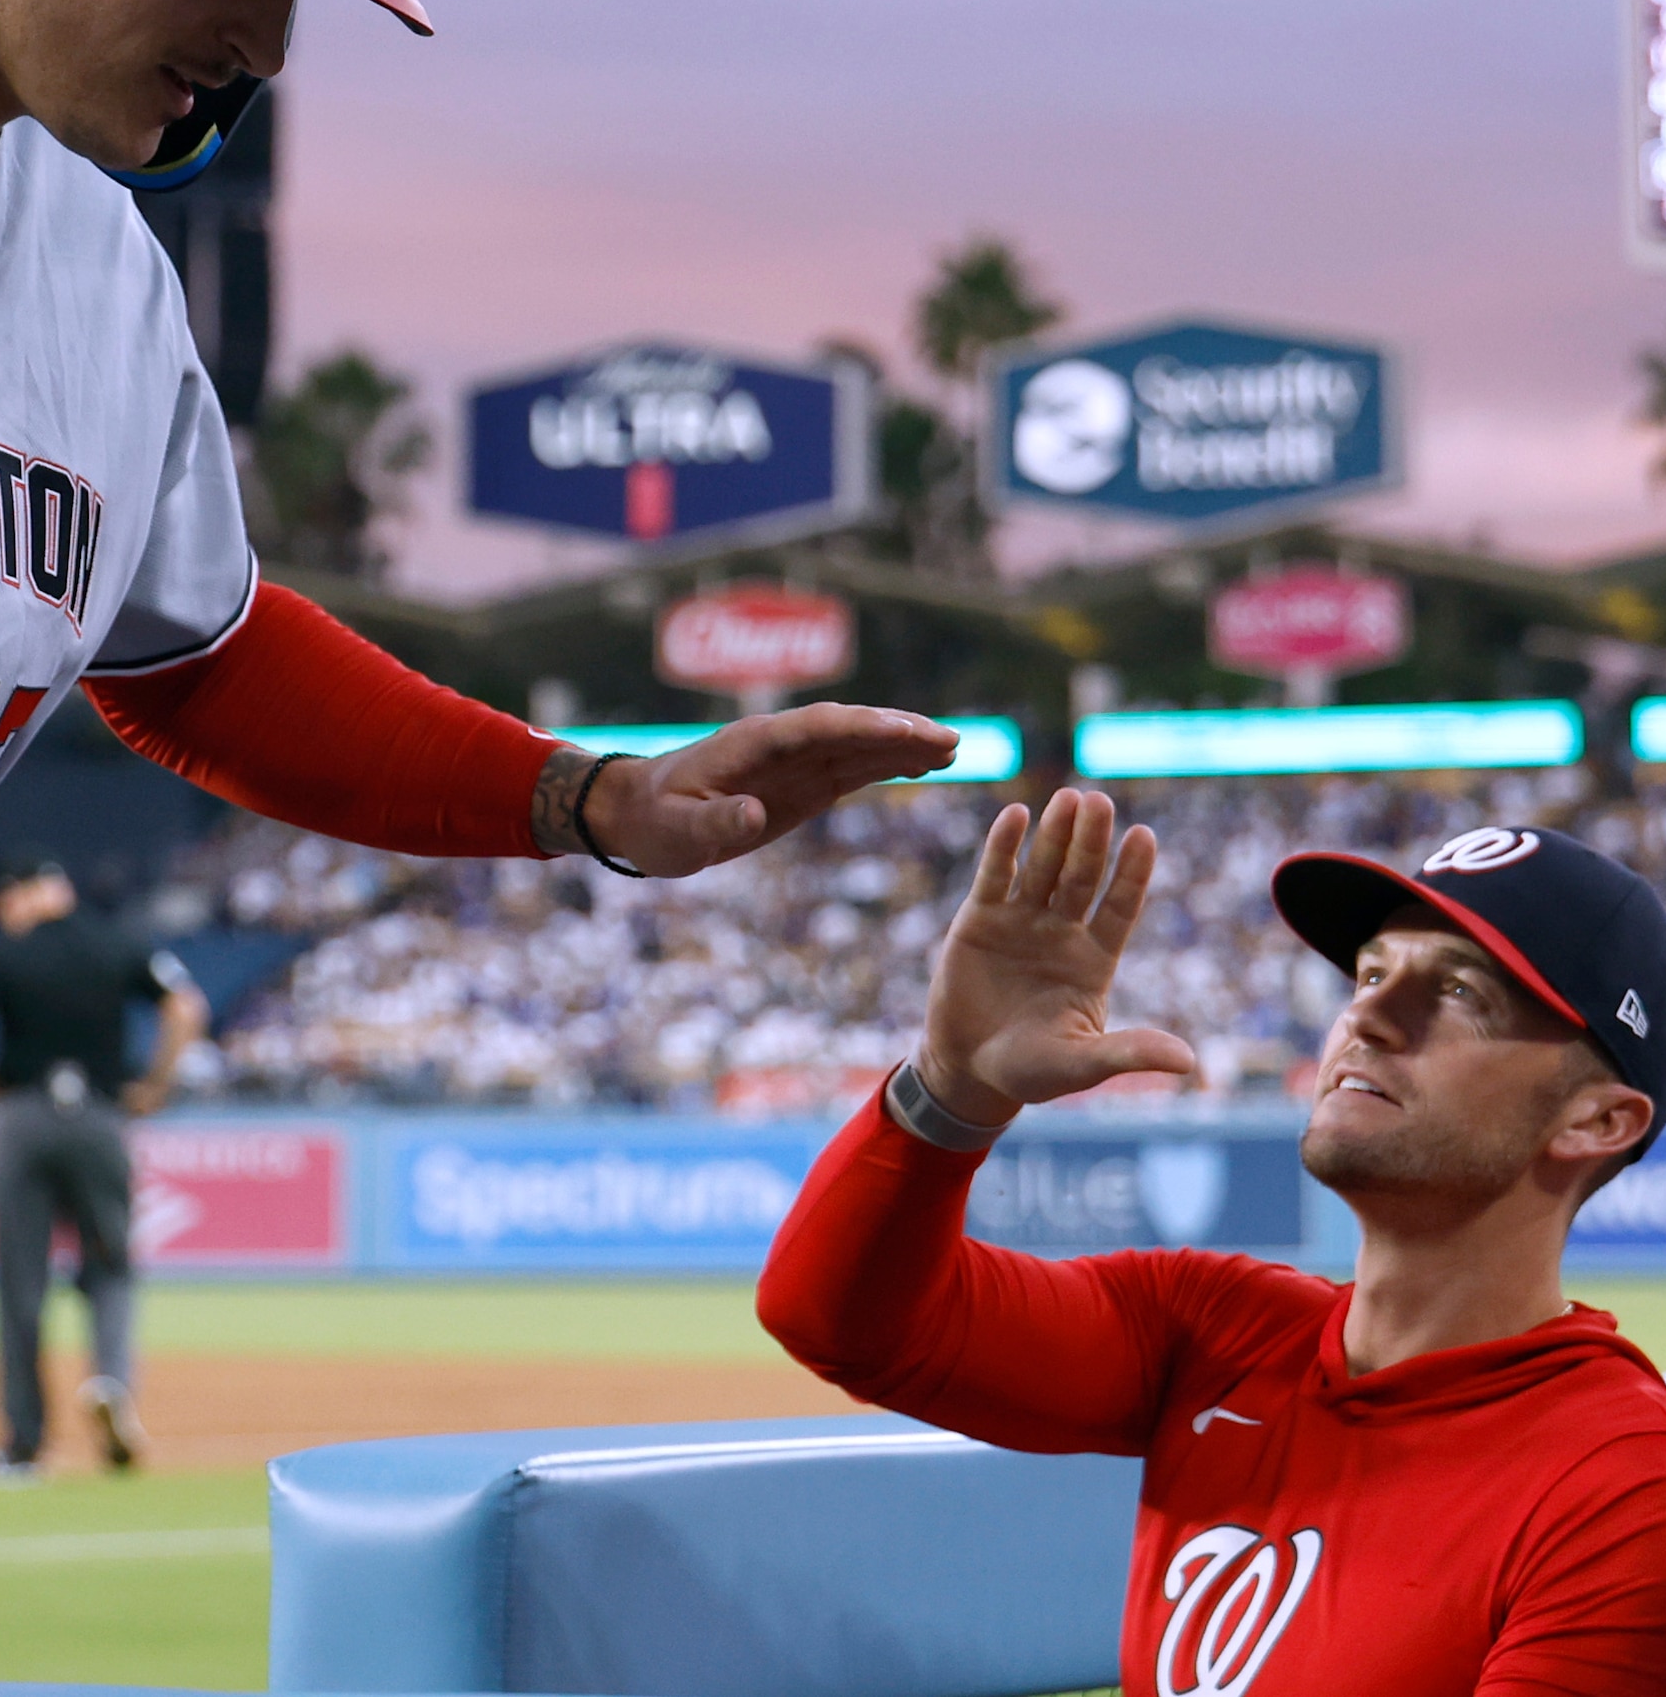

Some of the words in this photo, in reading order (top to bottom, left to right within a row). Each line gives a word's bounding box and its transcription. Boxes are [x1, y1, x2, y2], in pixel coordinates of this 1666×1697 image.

[529, 390, 771, 469] ULTRA
[1135, 351, 1369, 431] Security
[1137, 415, 1334, 492] Benefit
[414, 1144, 801, 1253] Spectrum
